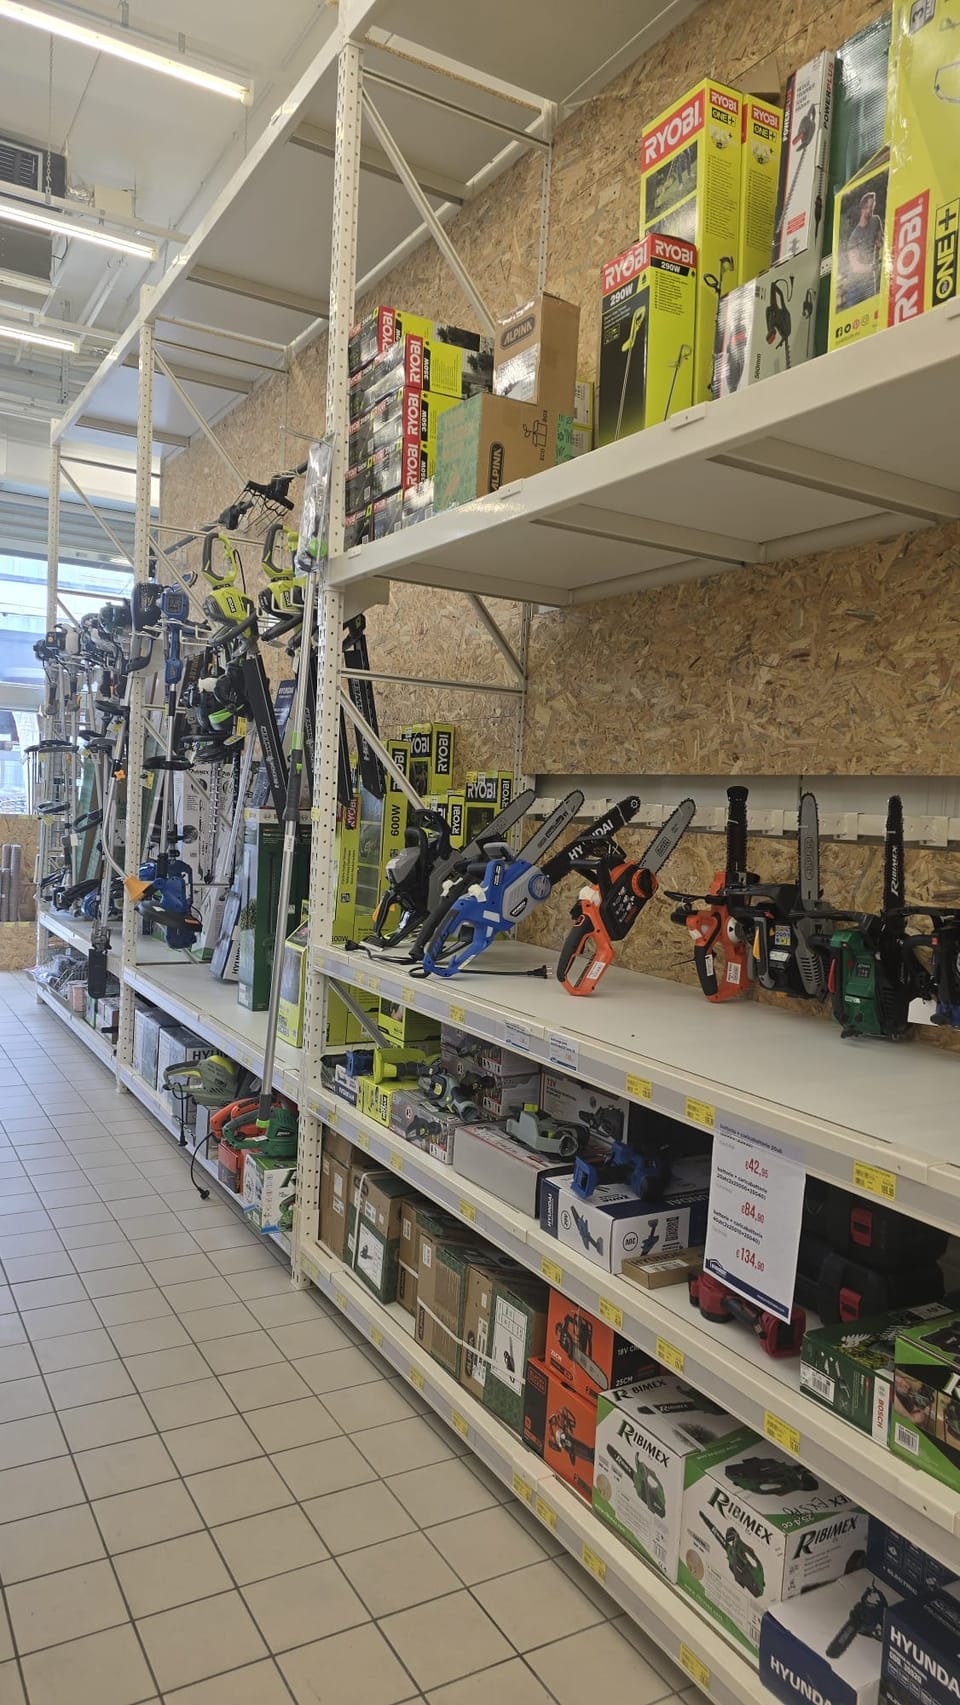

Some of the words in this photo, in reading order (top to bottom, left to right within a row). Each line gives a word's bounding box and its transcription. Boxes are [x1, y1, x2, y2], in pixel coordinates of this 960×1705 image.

[711, 91, 737, 112] RYOBI
[823, 62, 834, 130] POWERPLUS
[644, 101, 701, 164] RYOBI
[753, 108, 778, 128] RYOBI
[604, 243, 648, 289] RYOBI
[655, 240, 693, 264] RYOBI
[660, 261, 681, 273] 290W
[894, 204, 923, 325] RYOBI
[935, 207, 956, 299] ONE+
[609, 282, 633, 306] 290W
[409, 340, 422, 383] RYOBI
[407, 393, 419, 435] RYOBI
[406, 444, 419, 486] RYOBI
[410, 735, 430, 754] YOBI
[438, 734, 448, 773] RYOBI
[467, 783, 496, 799] RYOBI
[391, 804, 401, 837] 600W
[452, 805, 461, 835] RYOBI
[567, 819, 614, 861] HYDAI
[890, 845, 900, 897] RIBIMEX
[611, 1379, 667, 1402] RBIMEX
[615, 1376, 633, 1387] 25CM
[876, 1398, 885, 1429] BOSCH
[617, 1419, 671, 1468] RIBIMEX
[708, 1486, 774, 1545] RIBIMEX
[792, 1515, 859, 1561] RIBIMEX
